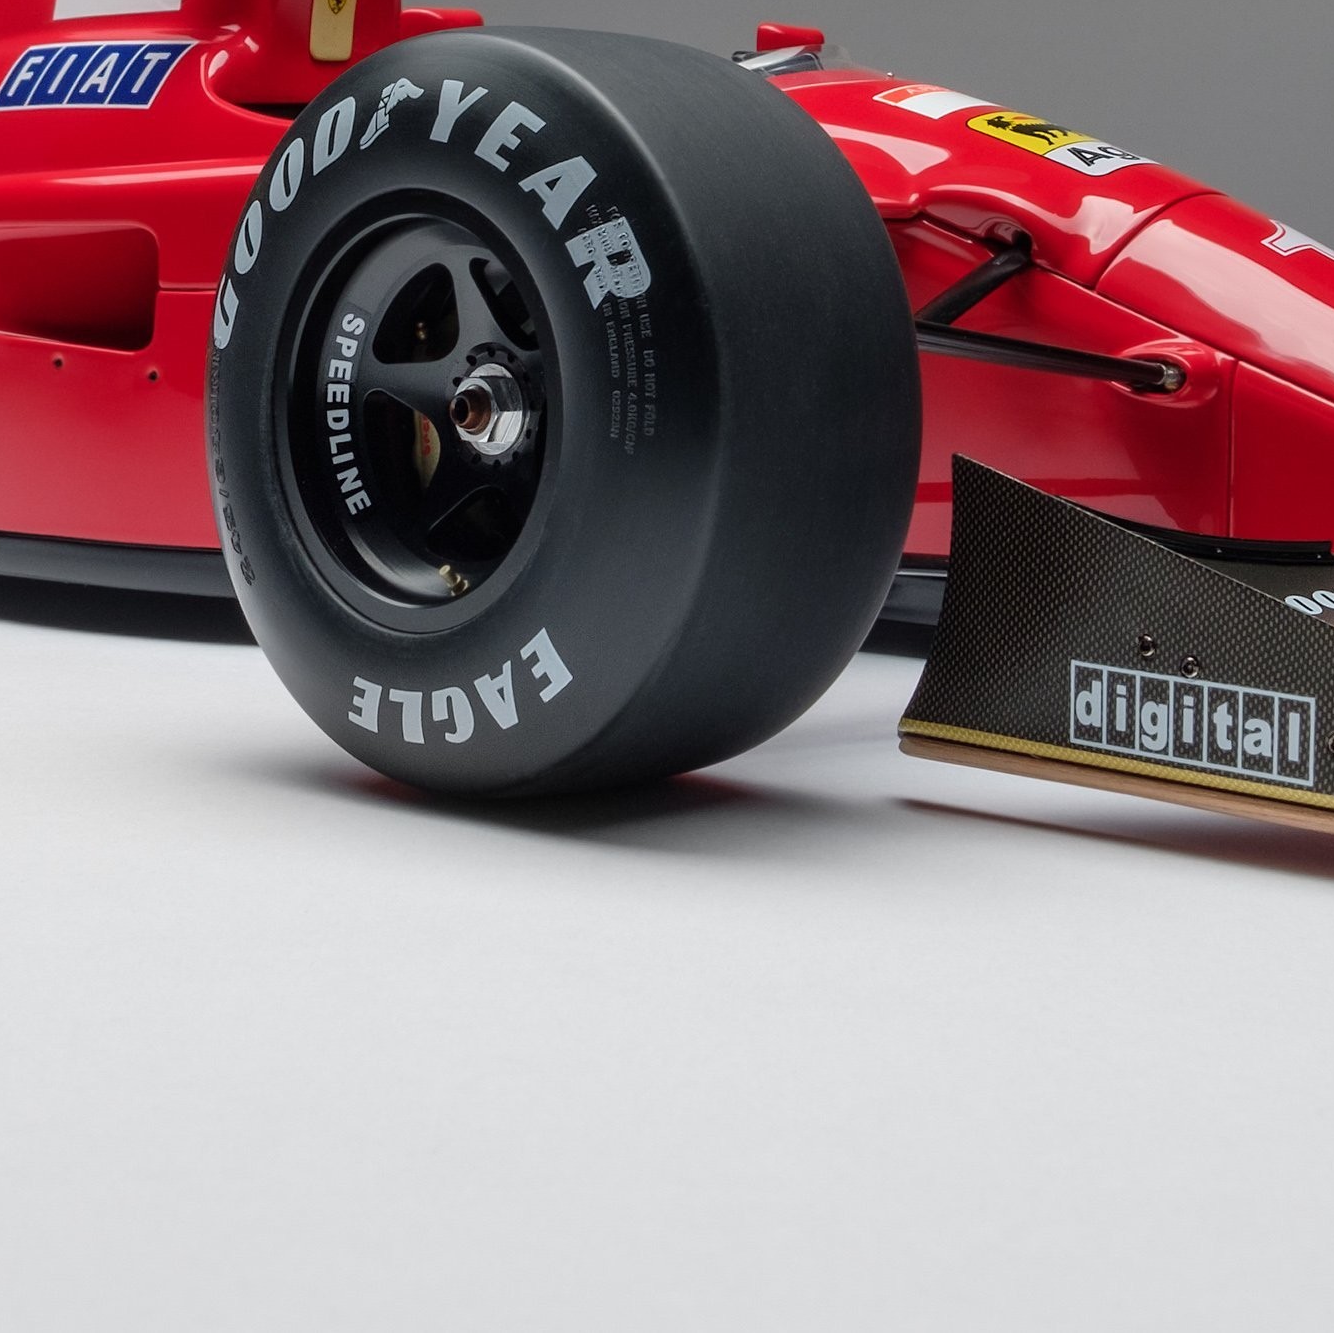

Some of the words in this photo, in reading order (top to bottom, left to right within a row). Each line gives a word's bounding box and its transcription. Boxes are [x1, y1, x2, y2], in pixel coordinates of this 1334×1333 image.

[5, 51, 172, 98] FIAT
[1067, 146, 1141, 167] Ag
[213, 78, 651, 349] GOODYEAR
[326, 312, 371, 516] SPEEDLINE
[348, 627, 573, 745] EAGLE
[1073, 681, 1303, 765] digital
